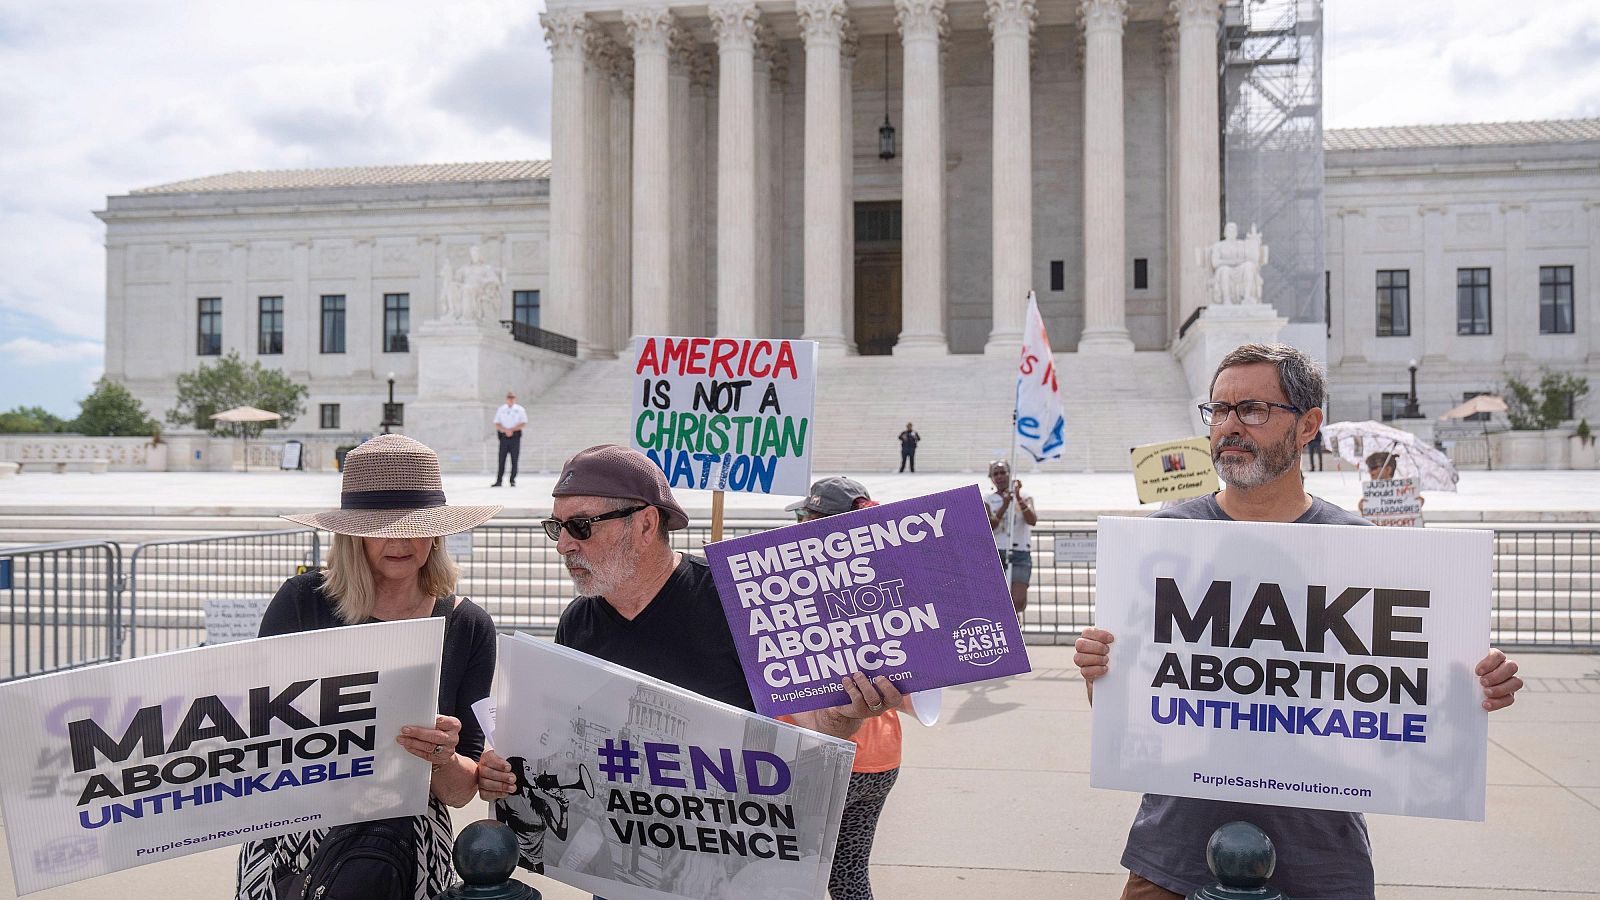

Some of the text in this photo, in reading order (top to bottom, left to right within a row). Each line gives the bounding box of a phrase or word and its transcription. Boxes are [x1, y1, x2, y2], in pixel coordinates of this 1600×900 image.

[636, 337, 798, 380] AMERICA
[643, 378, 781, 415] IS NOT A
[635, 409, 808, 458] CHRISTIAN
[646, 448, 778, 494] NATION
[1363, 489, 1394, 497] should
[1367, 479, 1413, 488] JUSTICES
[726, 508, 947, 582] EMERGENCY
[735, 557, 876, 608] ROOMS
[749, 578, 904, 636] ARE NOT
[1154, 577, 1430, 659] MAKE
[757, 602, 940, 663] ABORTION
[952, 622, 1004, 640] #PURPLE
[954, 631, 1008, 654] SASH
[958, 646, 1010, 662] REVOLUTION
[763, 640, 907, 688] CLINICS
[771, 670, 913, 703] PurpleSashReicom
[1150, 652, 1428, 706] ABORTION
[67, 670, 379, 773] MAKE
[1151, 695, 1427, 743] UNTHINKABLE
[76, 725, 376, 807] ABORTION
[598, 738, 792, 796] #END
[1193, 772, 1372, 798] PurpleSashRevolution.com
[79, 755, 375, 830] UNTHINKABLE
[607, 788, 795, 830] ABORTION
[136, 813, 322, 857] PurpleSashRevolution.com
[608, 818, 800, 861] VIOLENCE
